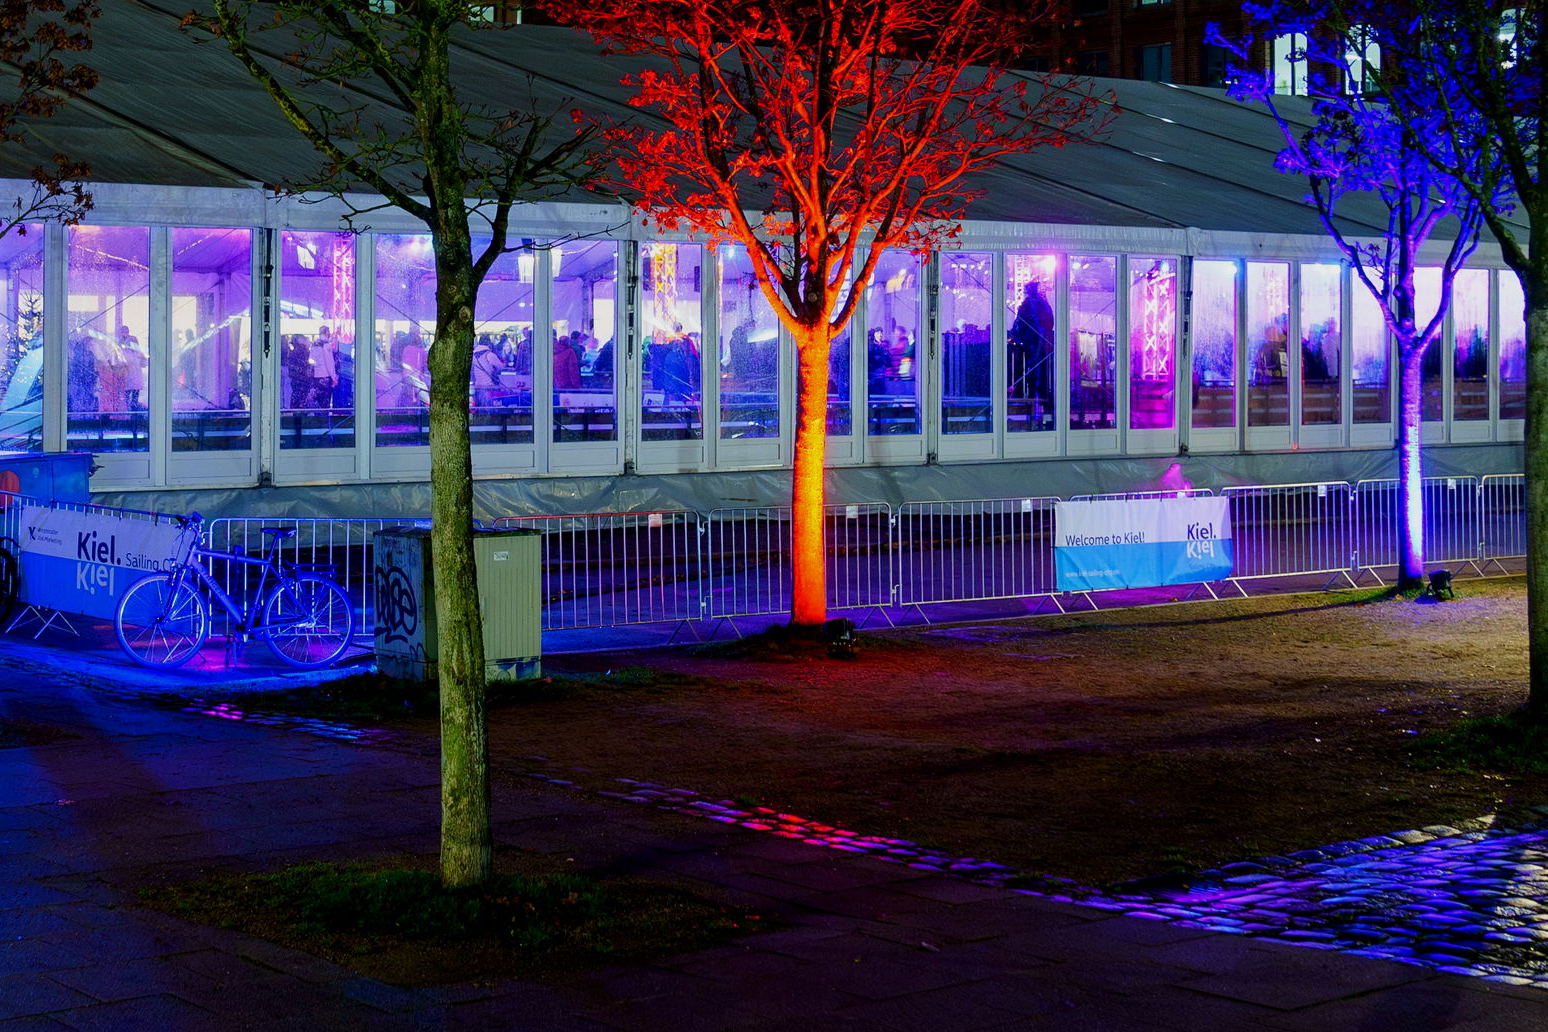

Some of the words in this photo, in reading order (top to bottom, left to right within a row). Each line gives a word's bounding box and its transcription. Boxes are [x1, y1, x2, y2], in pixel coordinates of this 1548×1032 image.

[1065, 535, 1110, 547] Welcome
[1112, 533, 1122, 545] to
[1124, 532, 1145, 544] Kiel!
[1187, 521, 1217, 541] Kiel.
[77, 530, 121, 566] Kiel.
[125, 552, 159, 571] Sailing
